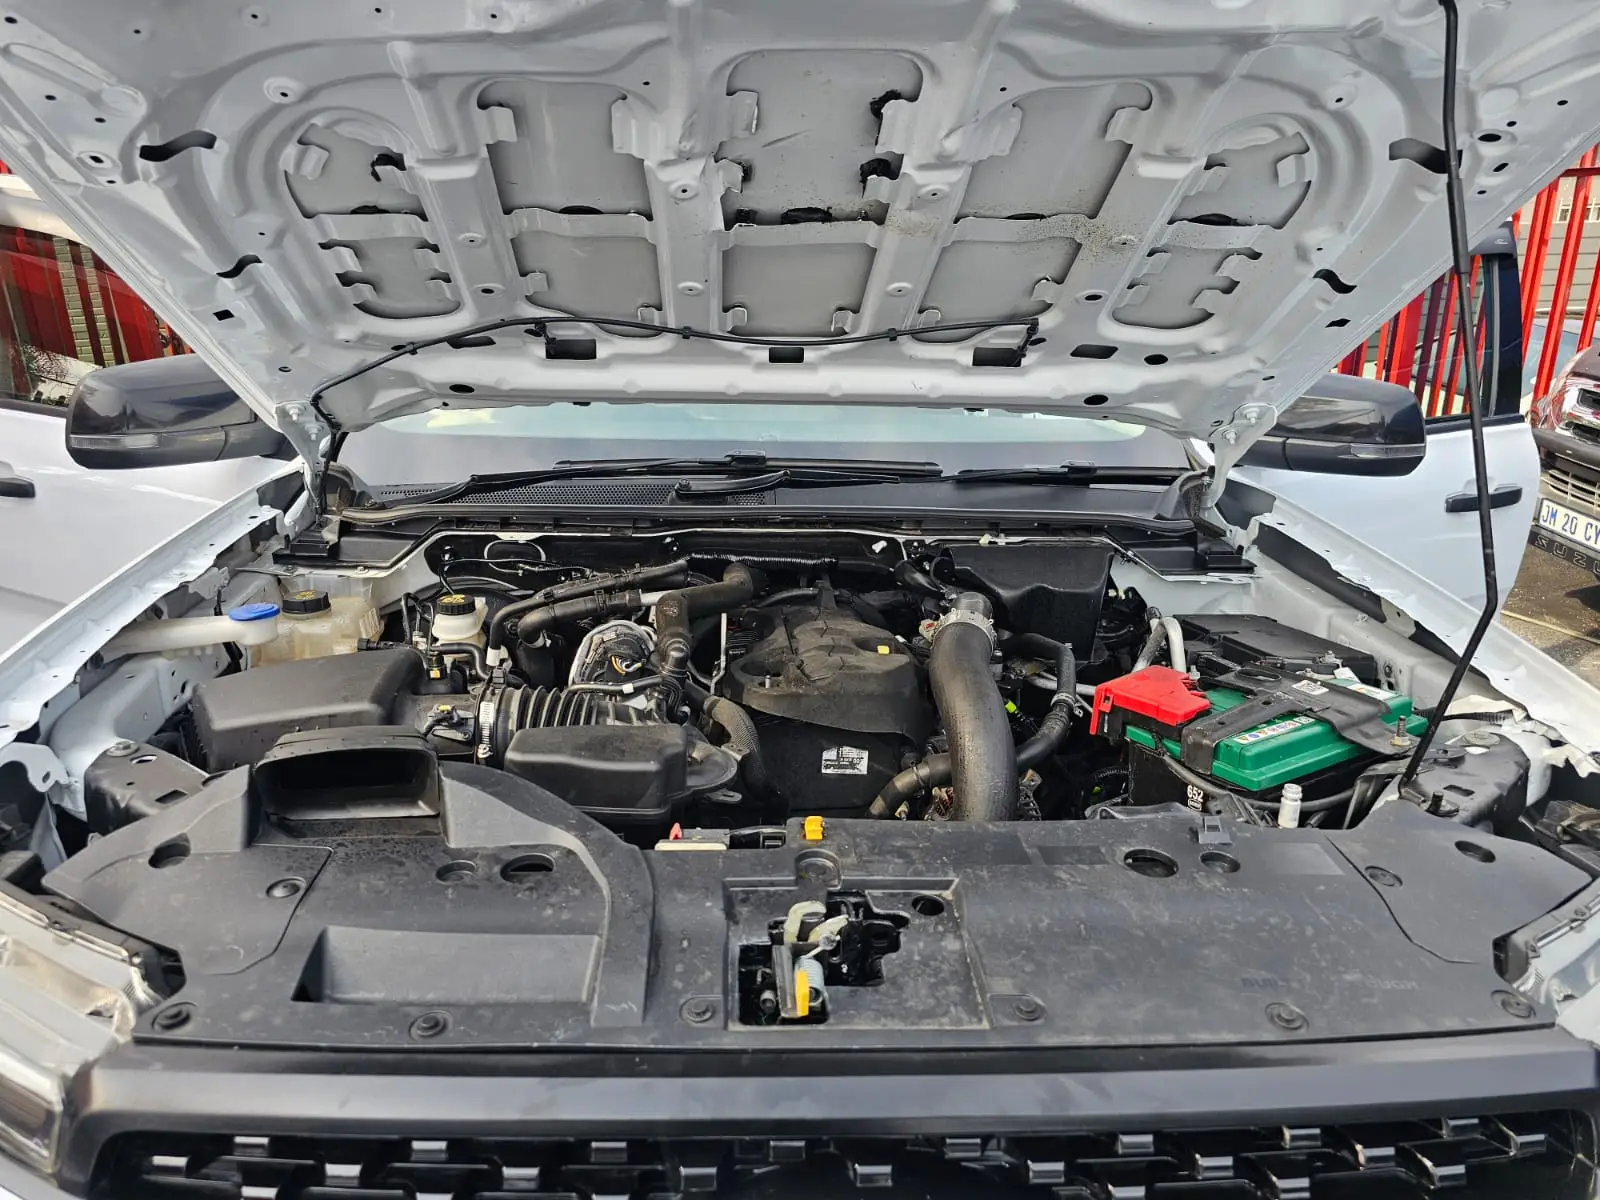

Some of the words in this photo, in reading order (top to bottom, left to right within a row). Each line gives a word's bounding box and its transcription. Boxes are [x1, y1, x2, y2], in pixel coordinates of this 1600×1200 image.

[1542, 504, 1558, 527] JM
[1561, 513, 1578, 535] 20
[1187, 784, 1203, 803] 652
